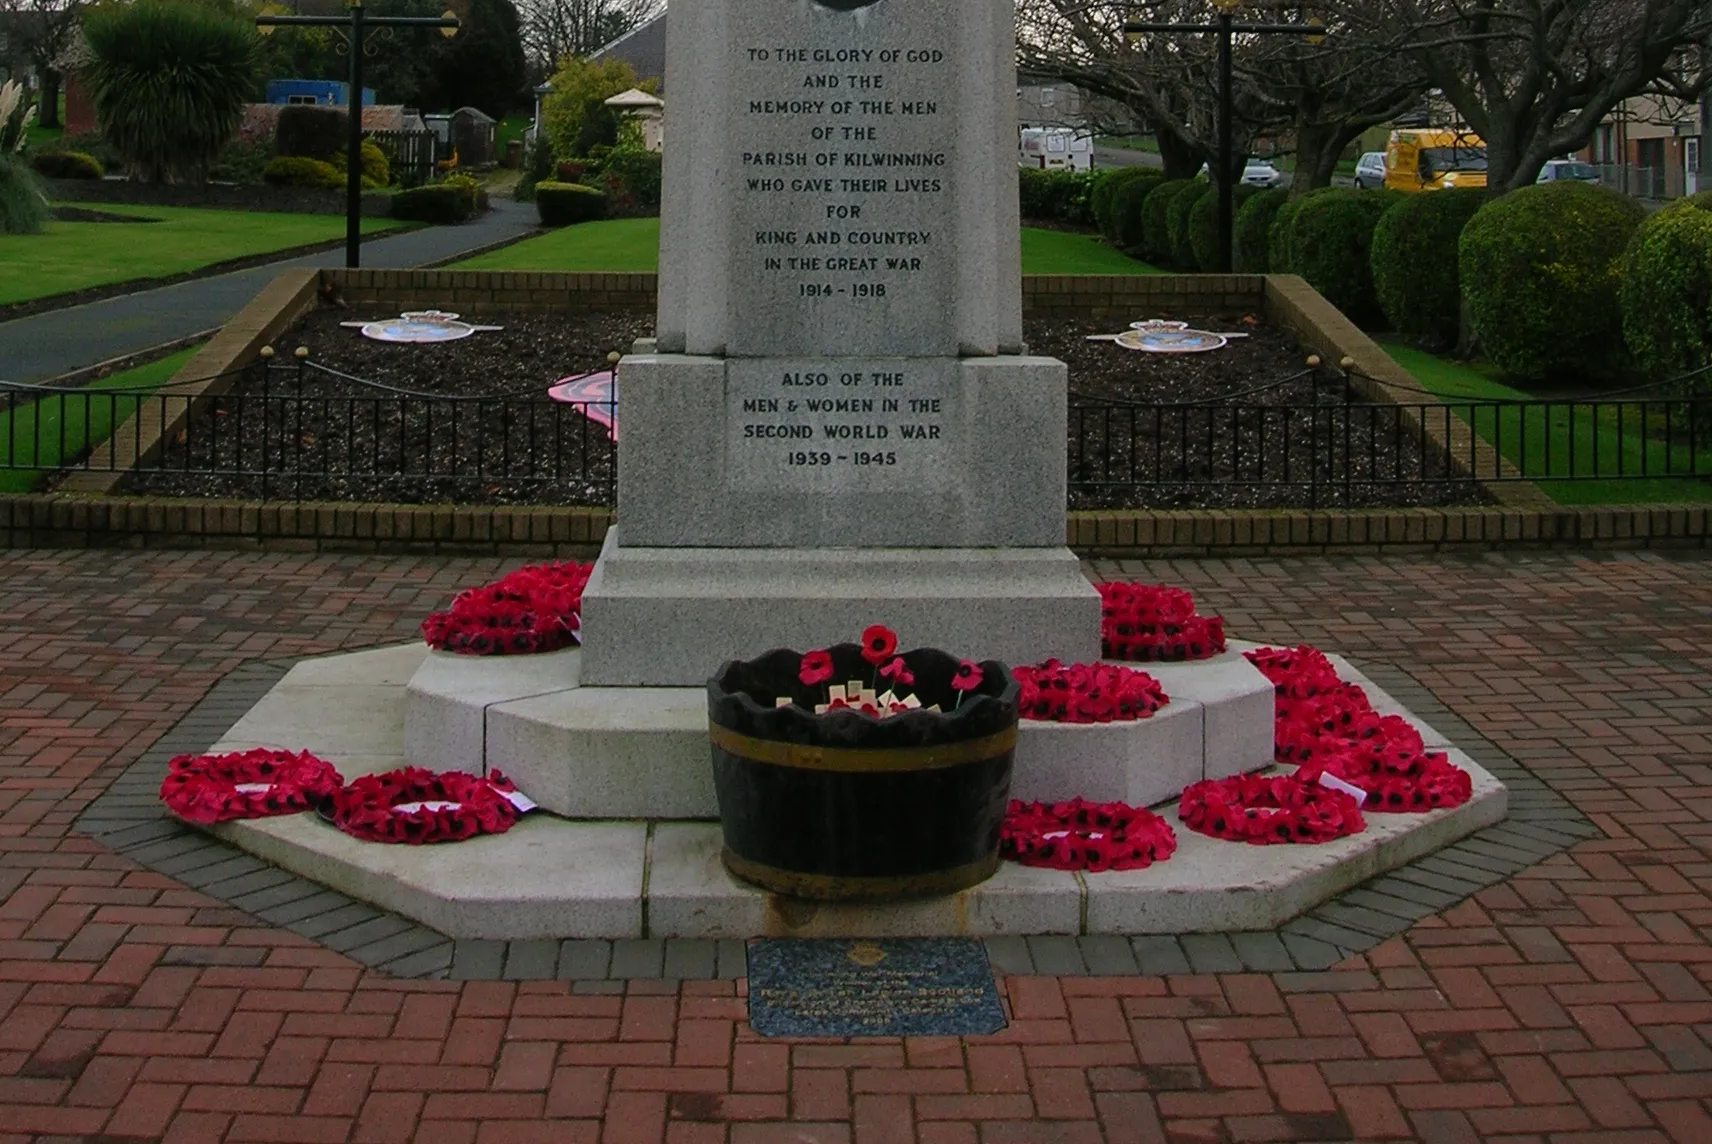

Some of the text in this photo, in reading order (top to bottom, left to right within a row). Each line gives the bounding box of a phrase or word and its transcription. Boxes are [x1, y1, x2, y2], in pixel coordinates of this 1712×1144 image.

[746, 47, 944, 64] TO THE GLORY OF GOD
[802, 74, 884, 90] AND THE
[748, 100, 938, 116] MEMORY OF THE MEN
[810, 126, 877, 141] OF THE
[742, 151, 946, 168] PARISH OF KILWINNING
[746, 177, 942, 193] WHO GAVE THEIR LIVES
[826, 204, 862, 220] FOR
[754, 230, 932, 246] KING AND COUNTRY
[764, 256, 922, 272] IN THE GREAT WAR
[799, 283, 833, 298] 1914
[852, 283, 887, 298] 1918
[781, 372, 905, 387] ALSO OF THE
[742, 397, 942, 414] MEN & WOMEN IN THE
[743, 424, 942, 440] SECOND WORLD WAR
[787, 451, 832, 467] 1939
[853, 451, 897, 467] 1945
